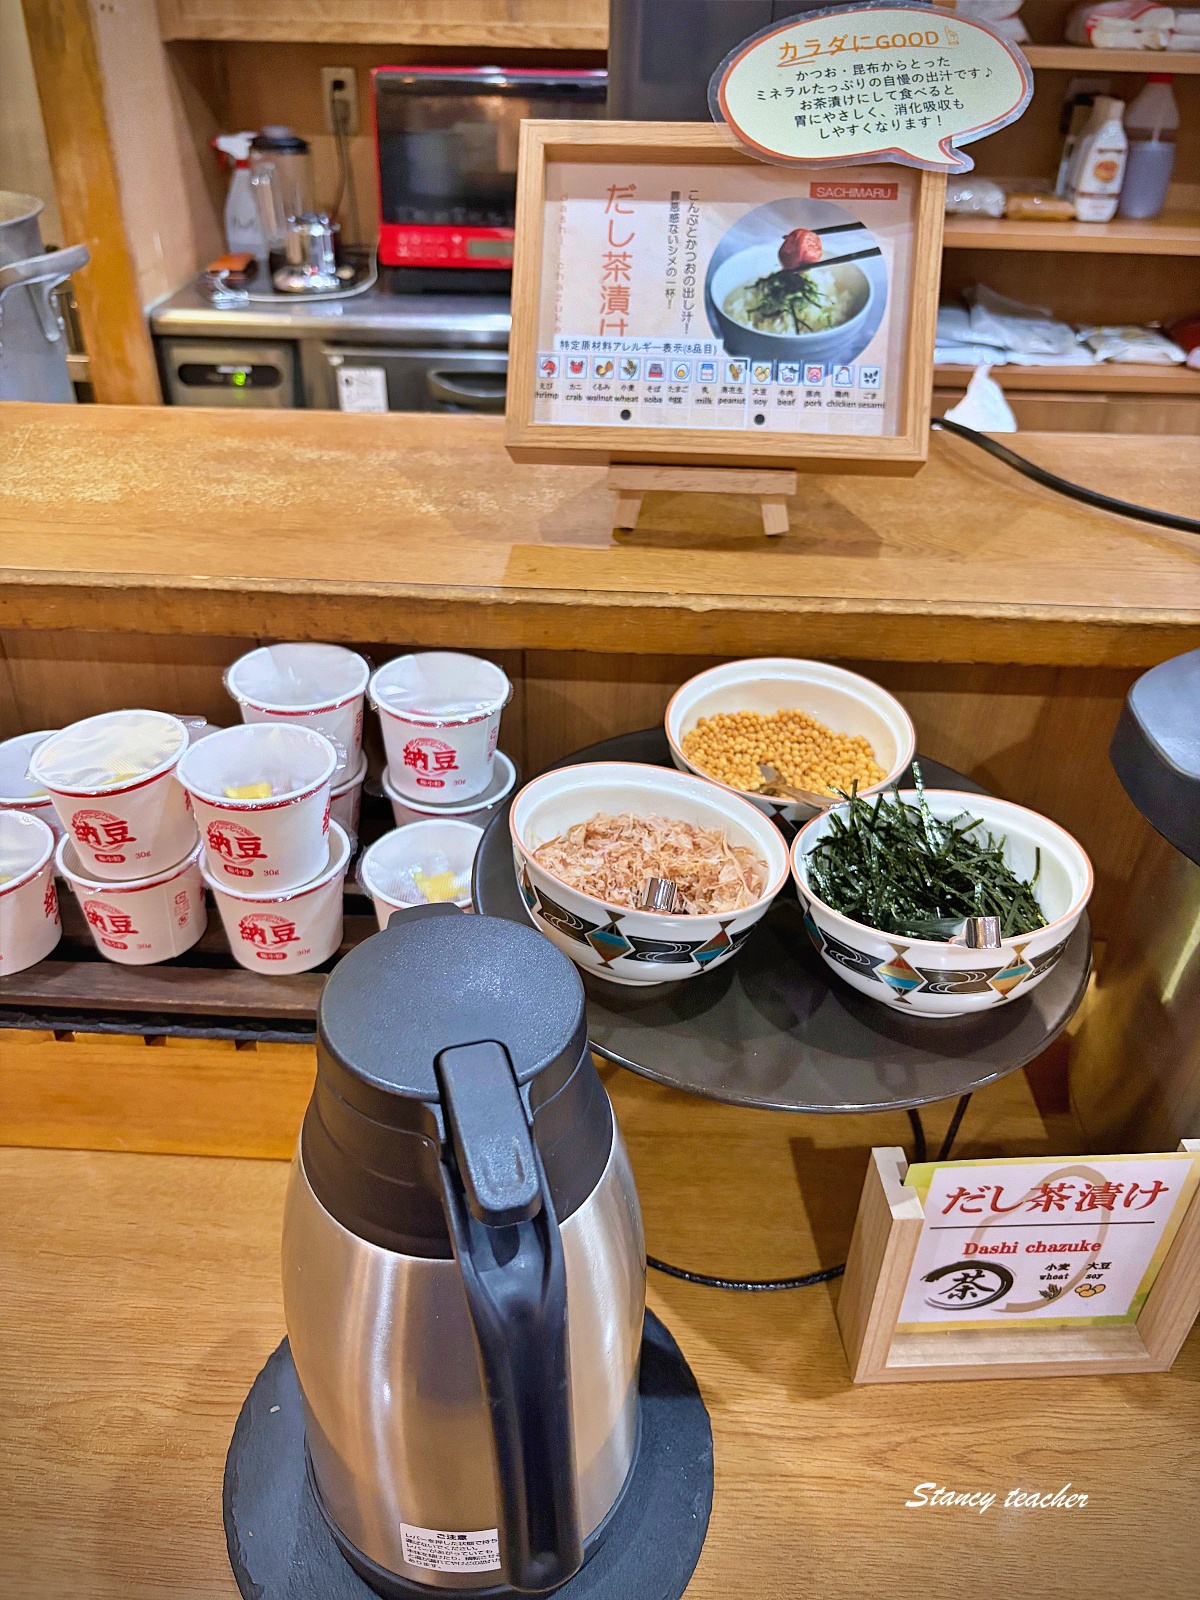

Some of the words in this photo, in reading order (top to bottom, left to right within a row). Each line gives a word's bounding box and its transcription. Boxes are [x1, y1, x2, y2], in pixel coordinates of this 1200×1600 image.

[778, 30, 941, 61] カラダにGOOD
[796, 56, 951, 82] かつお・昆布からとった
[800, 84, 955, 111] お茶漬けにして食べると
[794, 98, 965, 127] 胃にやさしく、消化吸収も
[815, 186, 892, 199] SACHIMARU
[600, 183, 637, 337] だし茶漬け
[403, 744, 460, 772] 納豆
[71, 820, 137, 846] 納豆
[206, 828, 269, 859] 納豆
[263, 869, 280, 877] 30g
[83, 906, 140, 934] 納豆
[239, 919, 302, 945] 納豆
[941, 1180, 1170, 1216] だし茶漬け
[962, 1241, 1019, 1257] Dashi
[1025, 1239, 1102, 1255] chazuke
[1039, 1272, 1070, 1281] wheat
[1085, 1272, 1104, 1281] soy
[1044, 1262, 1071, 1272] 小麦
[1086, 1261, 1112, 1271] 大豆
[938, 1270, 996, 1300] 茶
